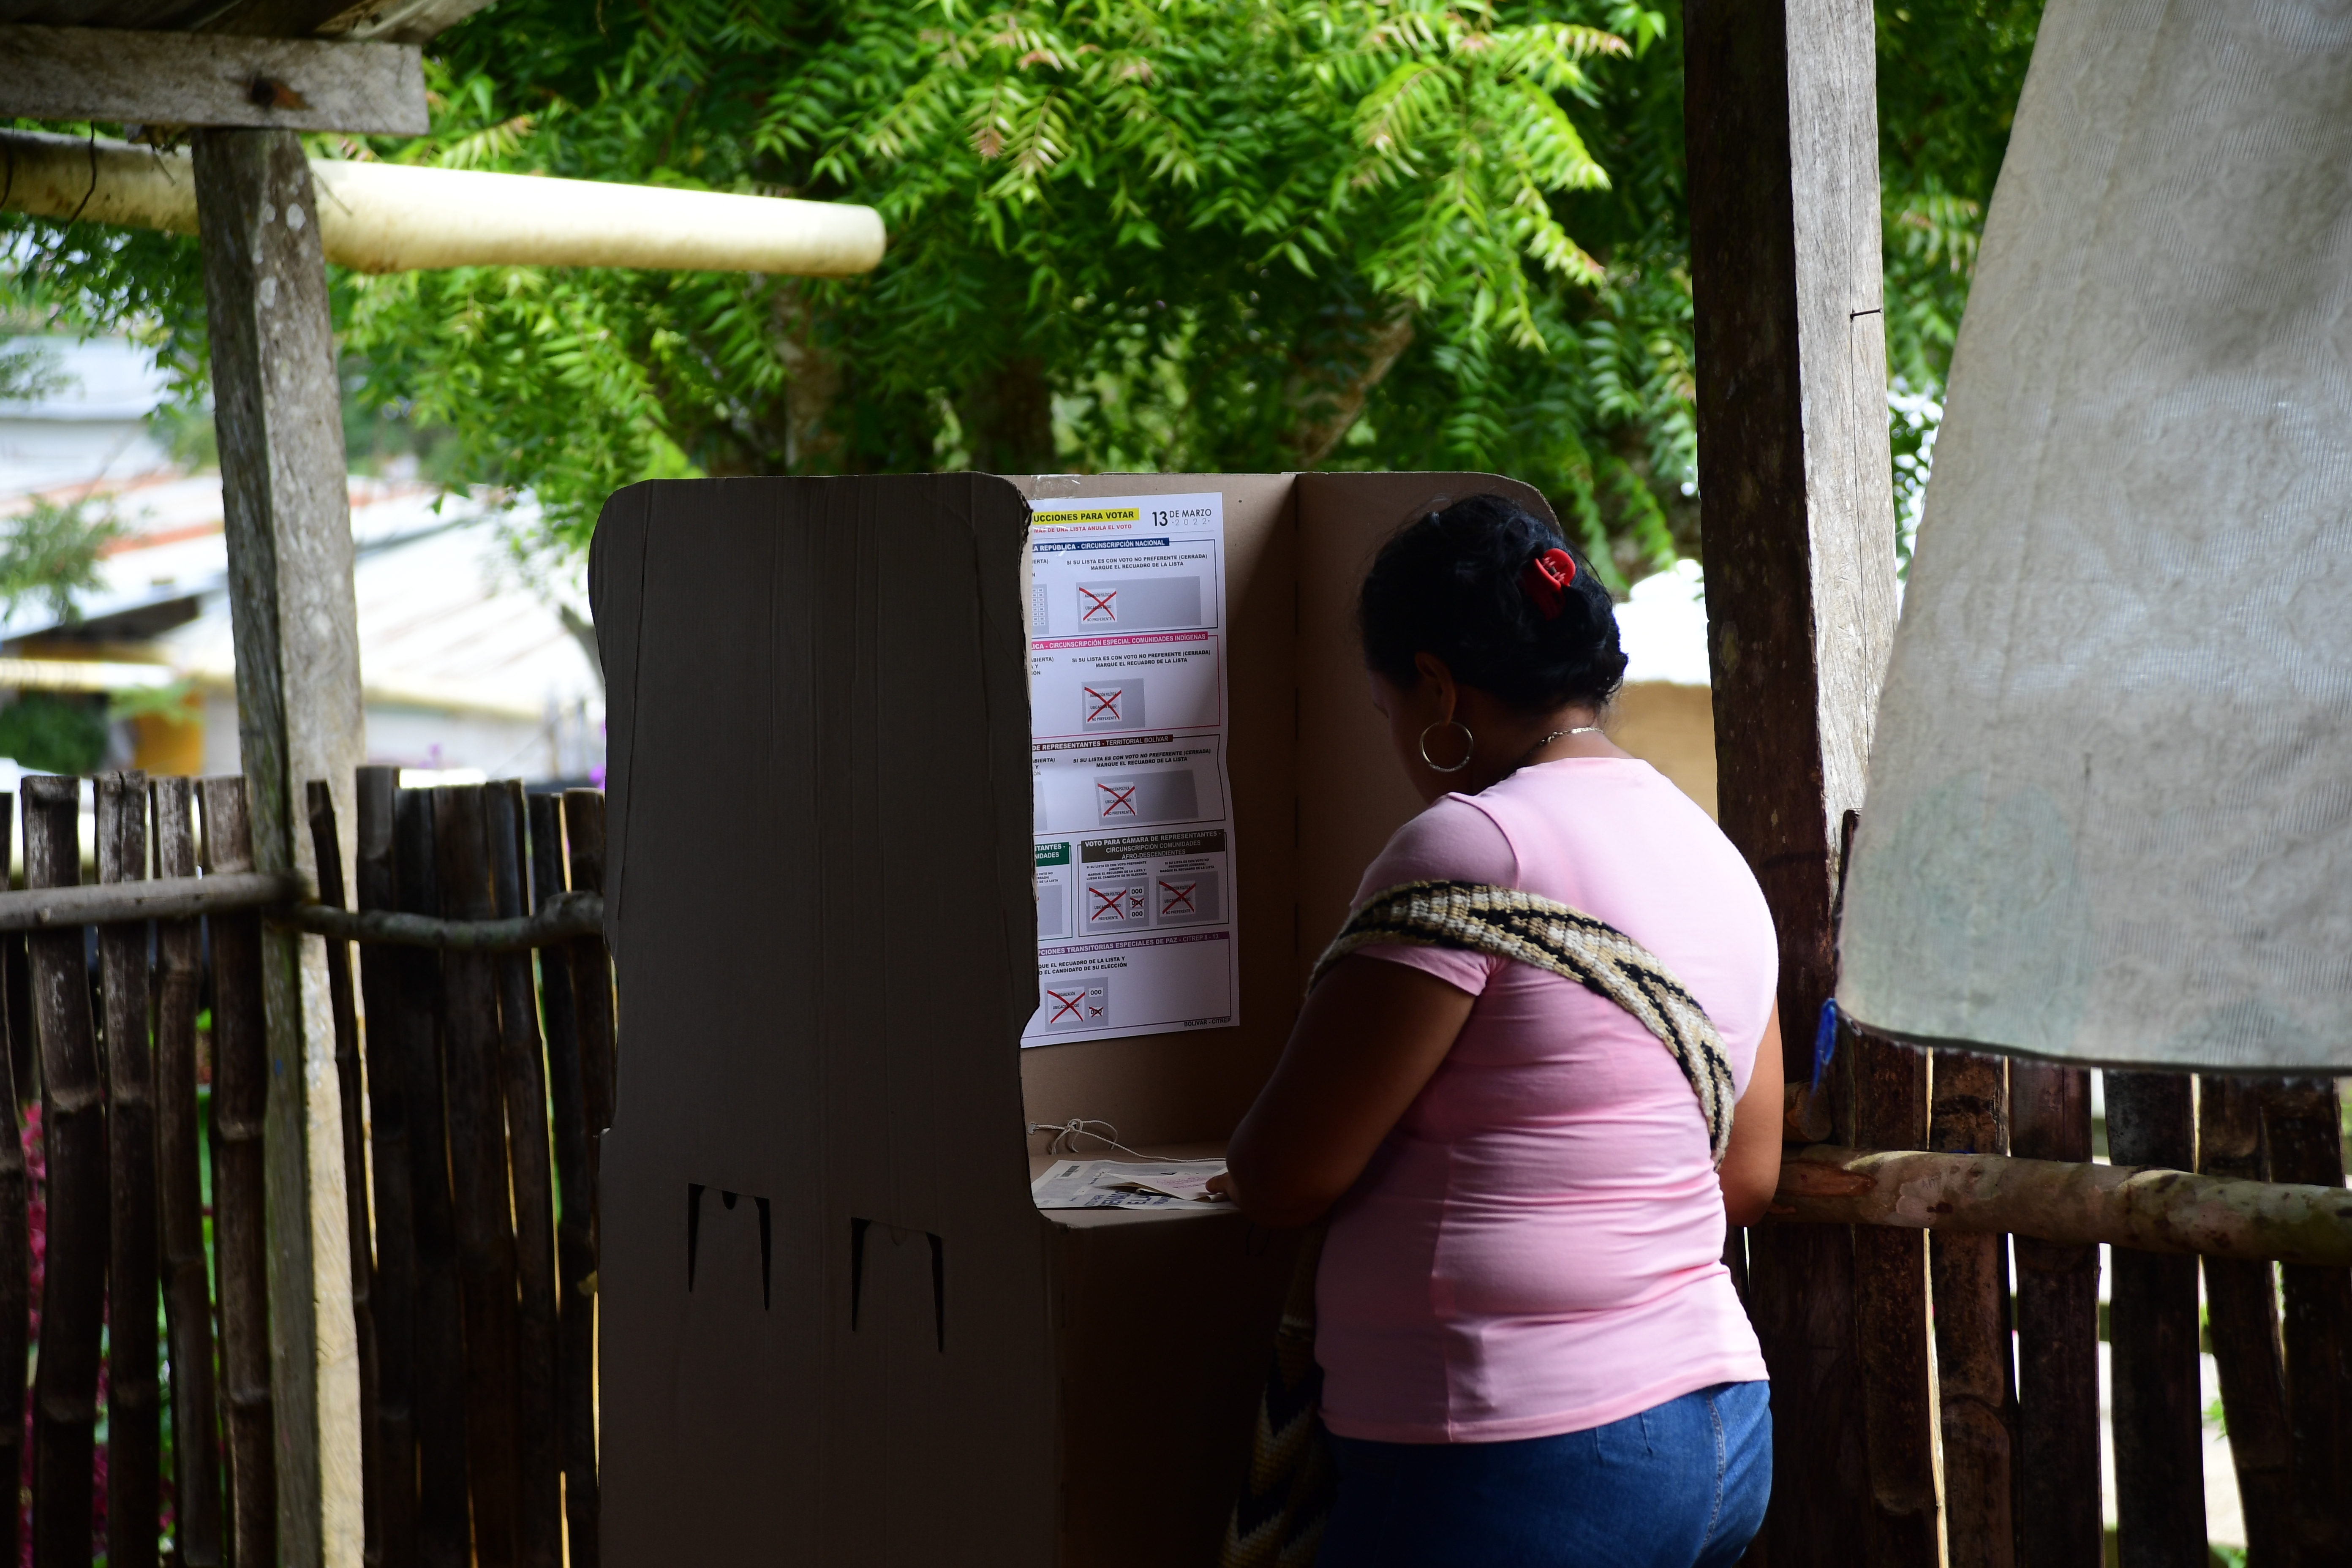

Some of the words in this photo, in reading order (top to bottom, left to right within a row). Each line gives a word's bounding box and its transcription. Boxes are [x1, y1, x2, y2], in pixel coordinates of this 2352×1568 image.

[1105, 511, 1134, 519] VOTAR
[1152, 511, 1168, 526] 13
[1169, 510, 1179, 518] DE
[1182, 509, 1211, 517] MARZO
[1081, 540, 1134, 549] CIRCUNSCRIPCIÓN
[1049, 639, 1102, 648] CIRCUNSCRIPCIÓN
[1132, 635, 1173, 643] COMUNIDADES
[1042, 741, 1101, 750] REPRESENTANTES
[1106, 738, 1143, 746] TERRITORIAL
[1122, 836, 1149, 844] CÁMARA
[1160, 831, 1217, 841] REPRESENTANTES
[1106, 843, 1158, 853] CIRCUNSCRIPCIÓN
[1159, 840, 1201, 849] COMUNIDADES
[1122, 849, 1186, 860] AFRO-DESCENDIENTES
[1067, 943, 1114, 953] TRANSITORIAS
[1115, 939, 1154, 948] ESPECIALES
[1101, 961, 1127, 969] ELECCIÓN
